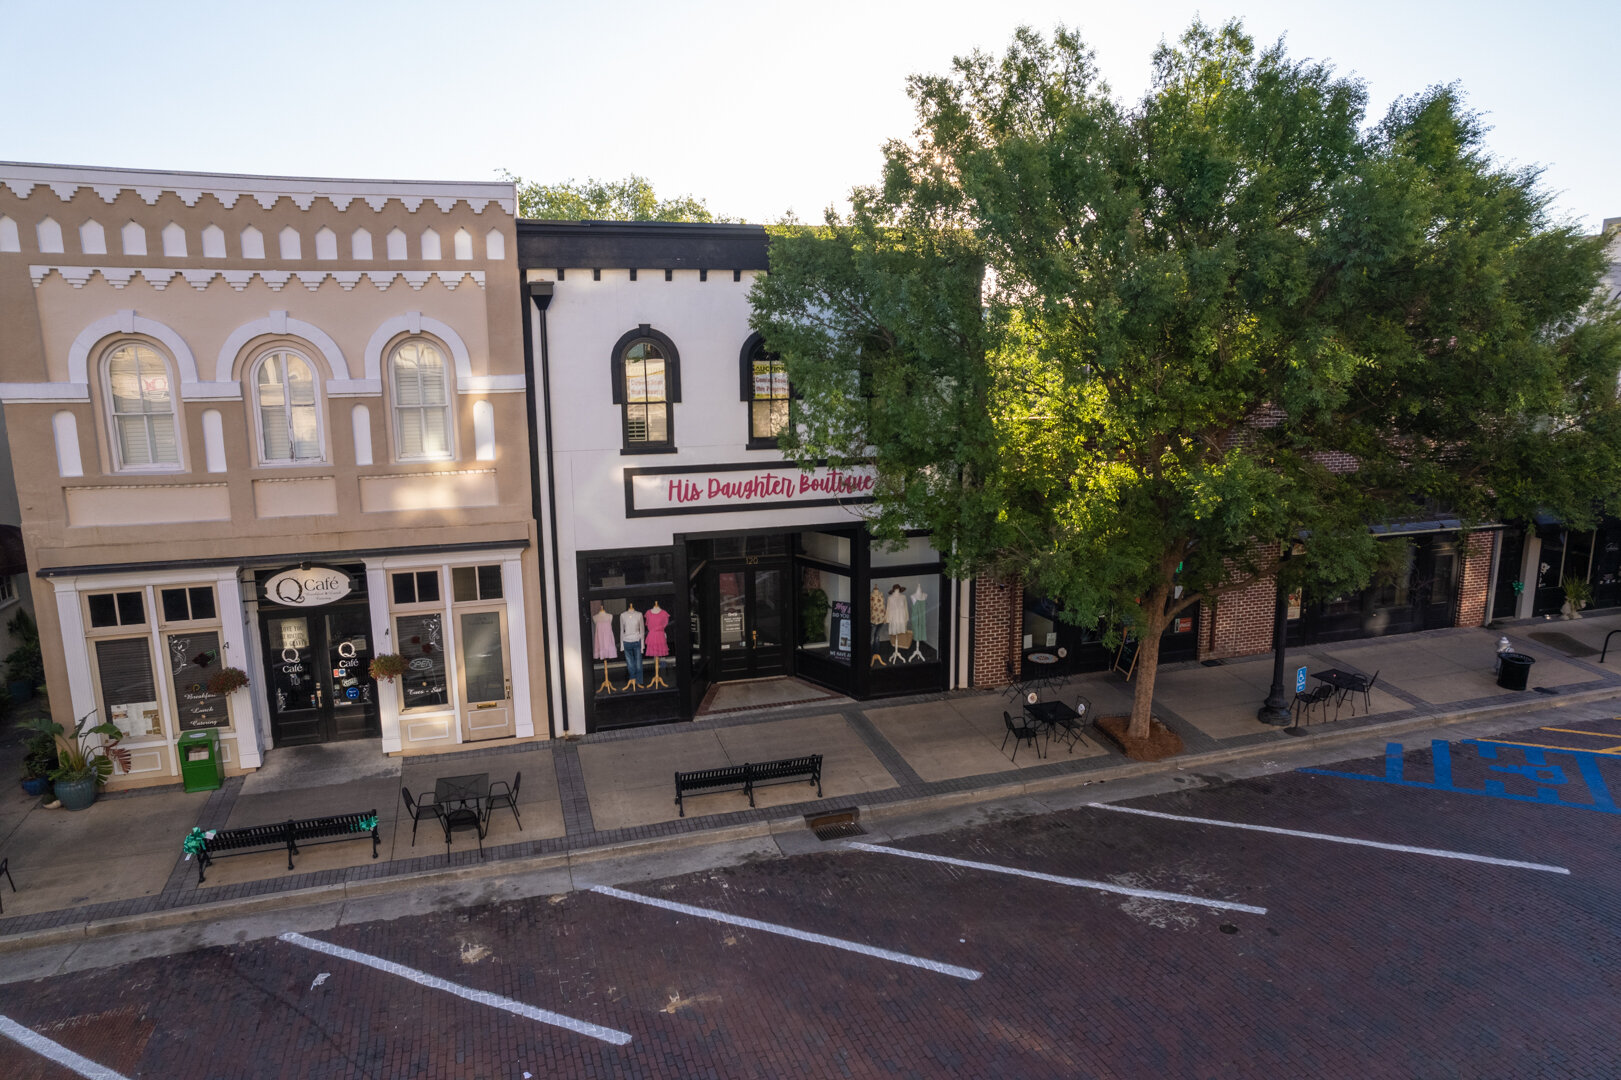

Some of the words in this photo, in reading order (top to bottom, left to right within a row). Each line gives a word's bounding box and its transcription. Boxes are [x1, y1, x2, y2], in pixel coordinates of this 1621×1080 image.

[668, 479, 703, 503] His
[707, 473, 795, 499] Daughter
[799, 469, 875, 494] Boutique
[276, 577, 305, 603] Q
[304, 576, 339, 591] Café
[282, 648, 301, 663] Q
[339, 642, 357, 658] Q
[282, 664, 303, 673] Café
[339, 659, 359, 668] Café
[409, 659, 433, 668] OPEN
